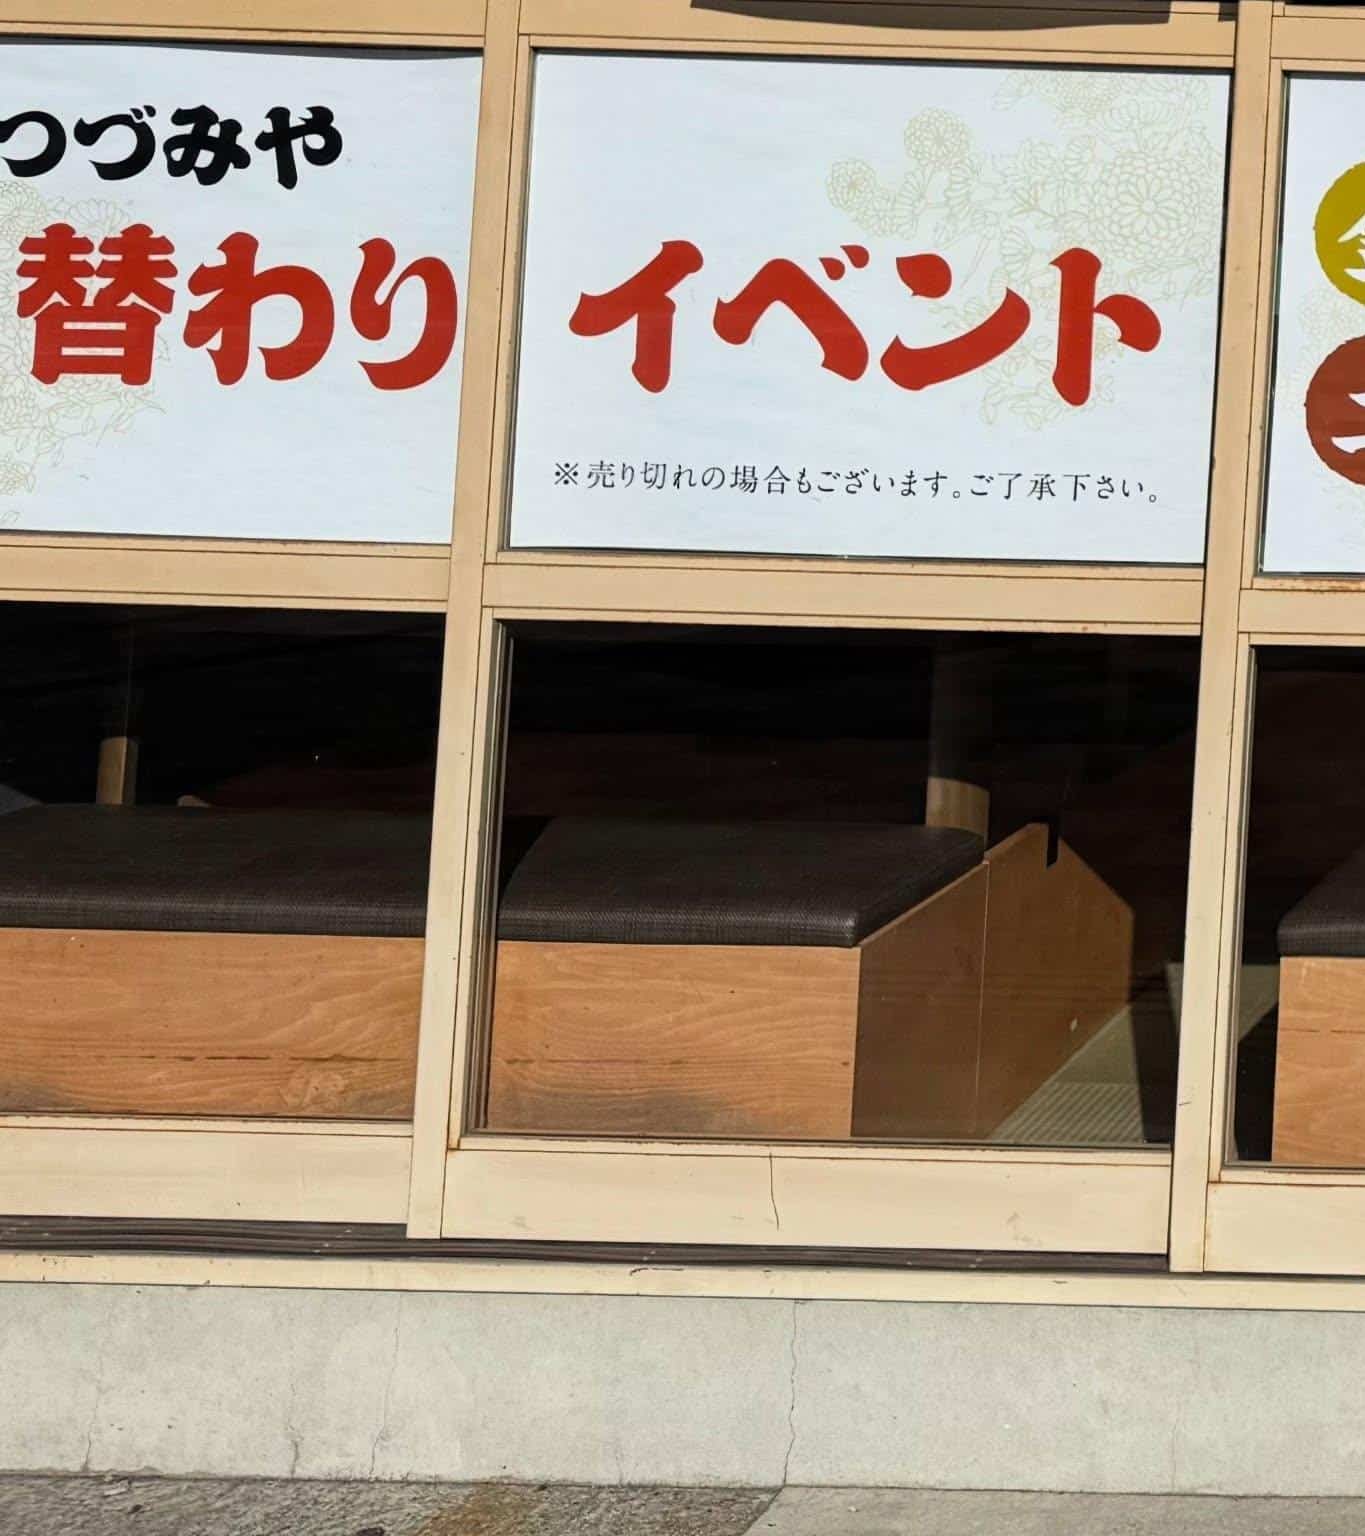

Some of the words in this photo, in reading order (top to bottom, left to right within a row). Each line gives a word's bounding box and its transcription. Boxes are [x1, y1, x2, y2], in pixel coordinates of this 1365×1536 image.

[0, 105, 343, 189] つづみや
[16, 223, 458, 391] 替わり
[569, 239, 1161, 407] イベント
